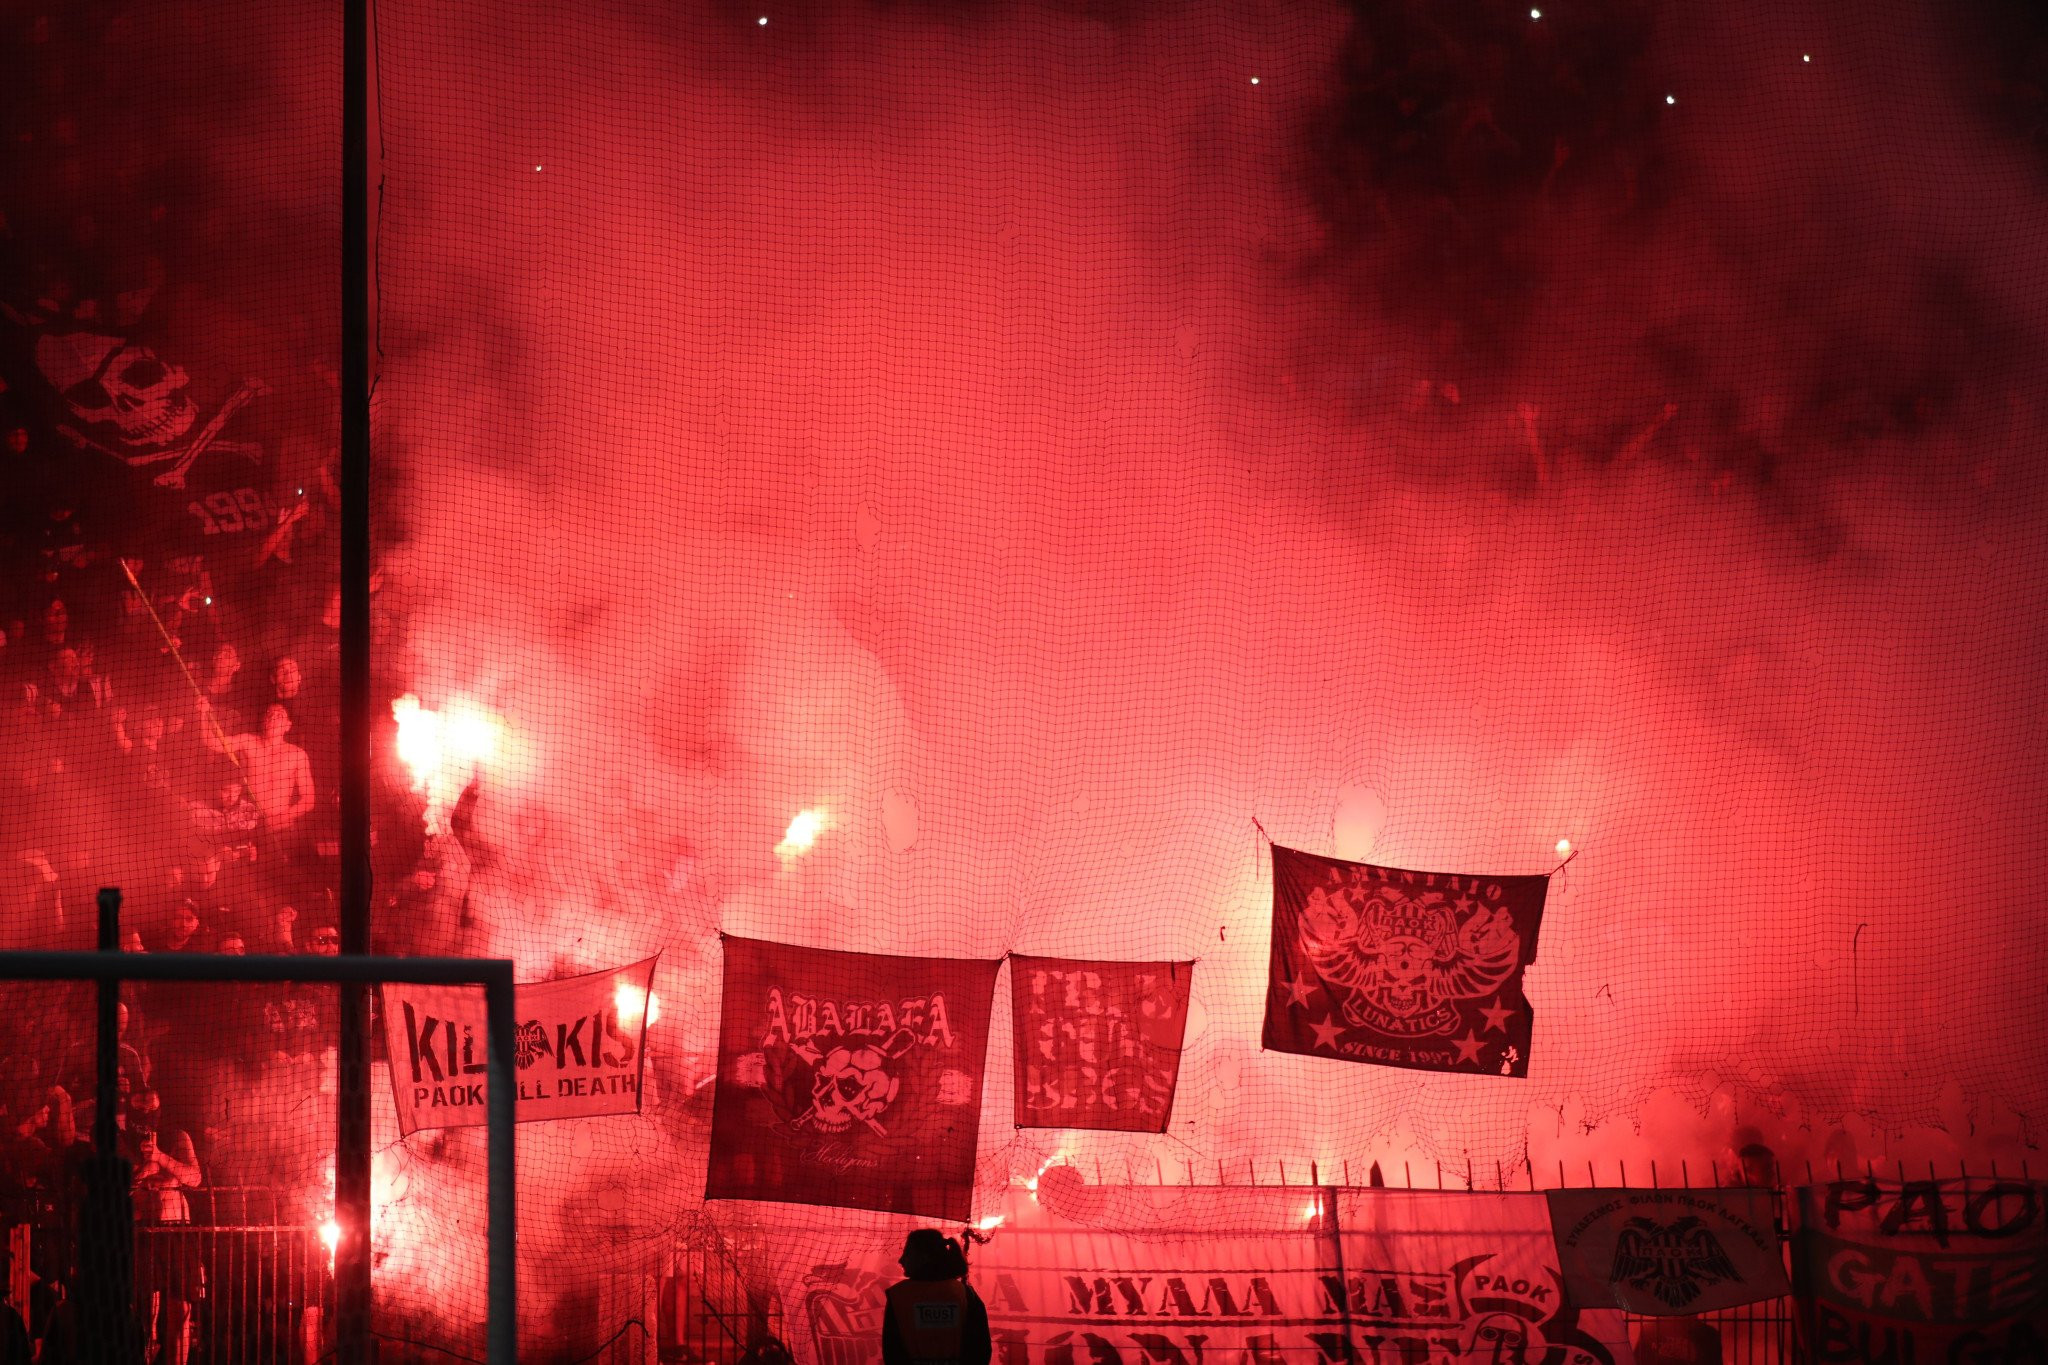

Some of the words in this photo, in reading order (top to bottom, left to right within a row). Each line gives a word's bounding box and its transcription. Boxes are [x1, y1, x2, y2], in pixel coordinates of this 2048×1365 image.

[1350, 998, 1453, 1032] LUNATICS
[1340, 1041, 1401, 1062] SINCE
[1408, 1051, 1454, 1066] 1997
[414, 1084, 484, 1109] PAOK
[512, 1079, 550, 1101] ILL
[558, 1074, 637, 1098] DEATH
[1630, 1193, 1673, 1206] ΦΙΛΩΝ
[1678, 1195, 1717, 1213] ΠΑΟΚ
[1475, 1275, 1553, 1304] PAOK
[1828, 1250, 2038, 1321] GATE
[916, 1304, 958, 1321] TRUST
